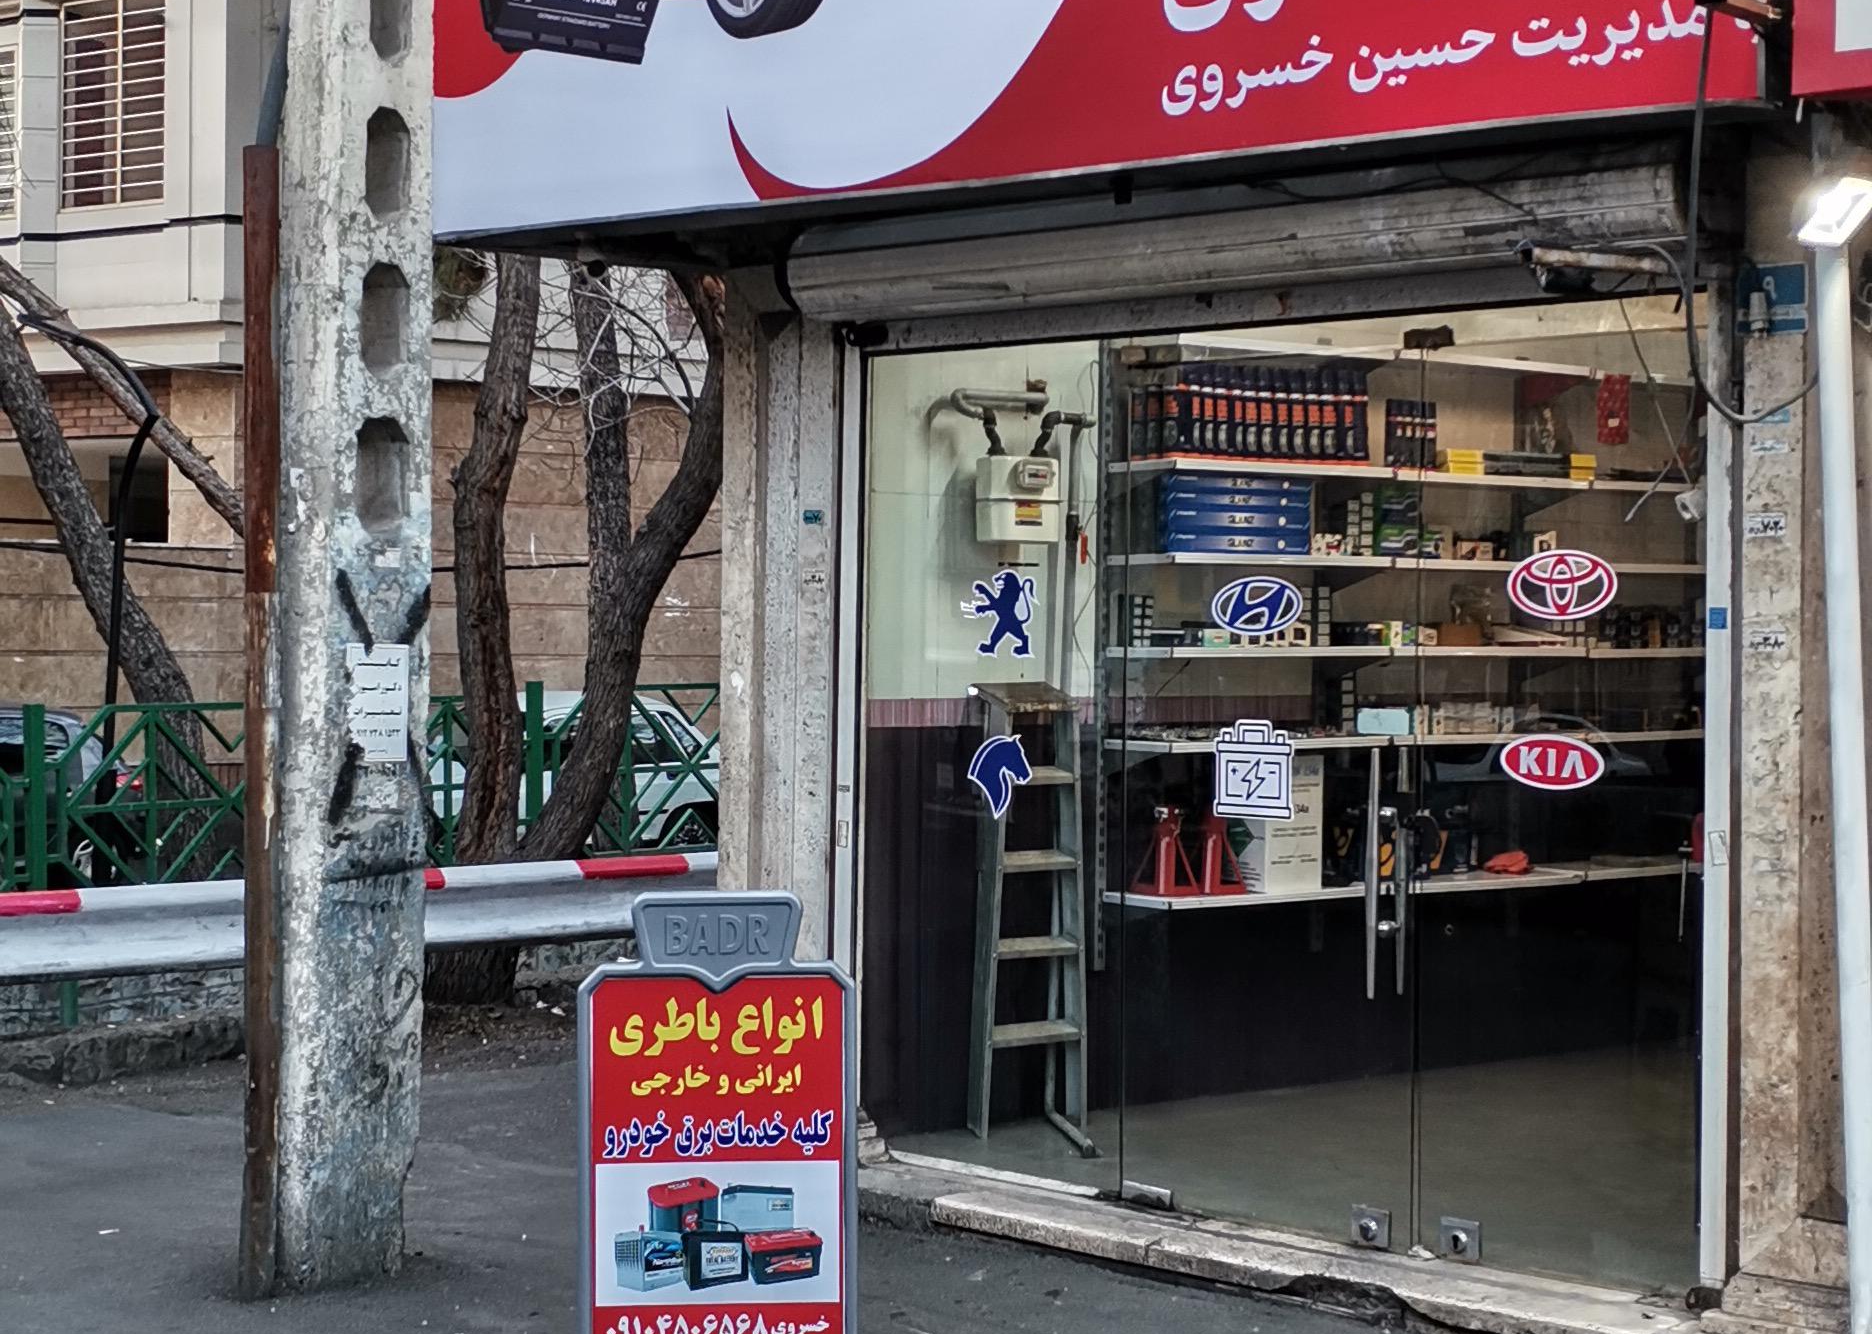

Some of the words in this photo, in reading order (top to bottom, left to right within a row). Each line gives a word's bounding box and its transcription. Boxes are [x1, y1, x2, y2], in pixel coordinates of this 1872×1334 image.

[1161, 33, 1334, 116] خسروی
[1348, 29, 1496, 93] حسین
[1519, 745, 1587, 779] KIA
[664, 913, 769, 956] BADR
[609, 996, 721, 1056] باطری
[731, 996, 824, 1055] انواع
[631, 1064, 710, 1096] خارجی
[716, 1073, 730, 1095] و
[735, 1063, 802, 1094] ایرانی
[603, 1109, 671, 1158] خودرو
[675, 1115, 715, 1156] برق
[715, 1110, 788, 1147] خدمات
[792, 1109, 834, 1155] کلیه
